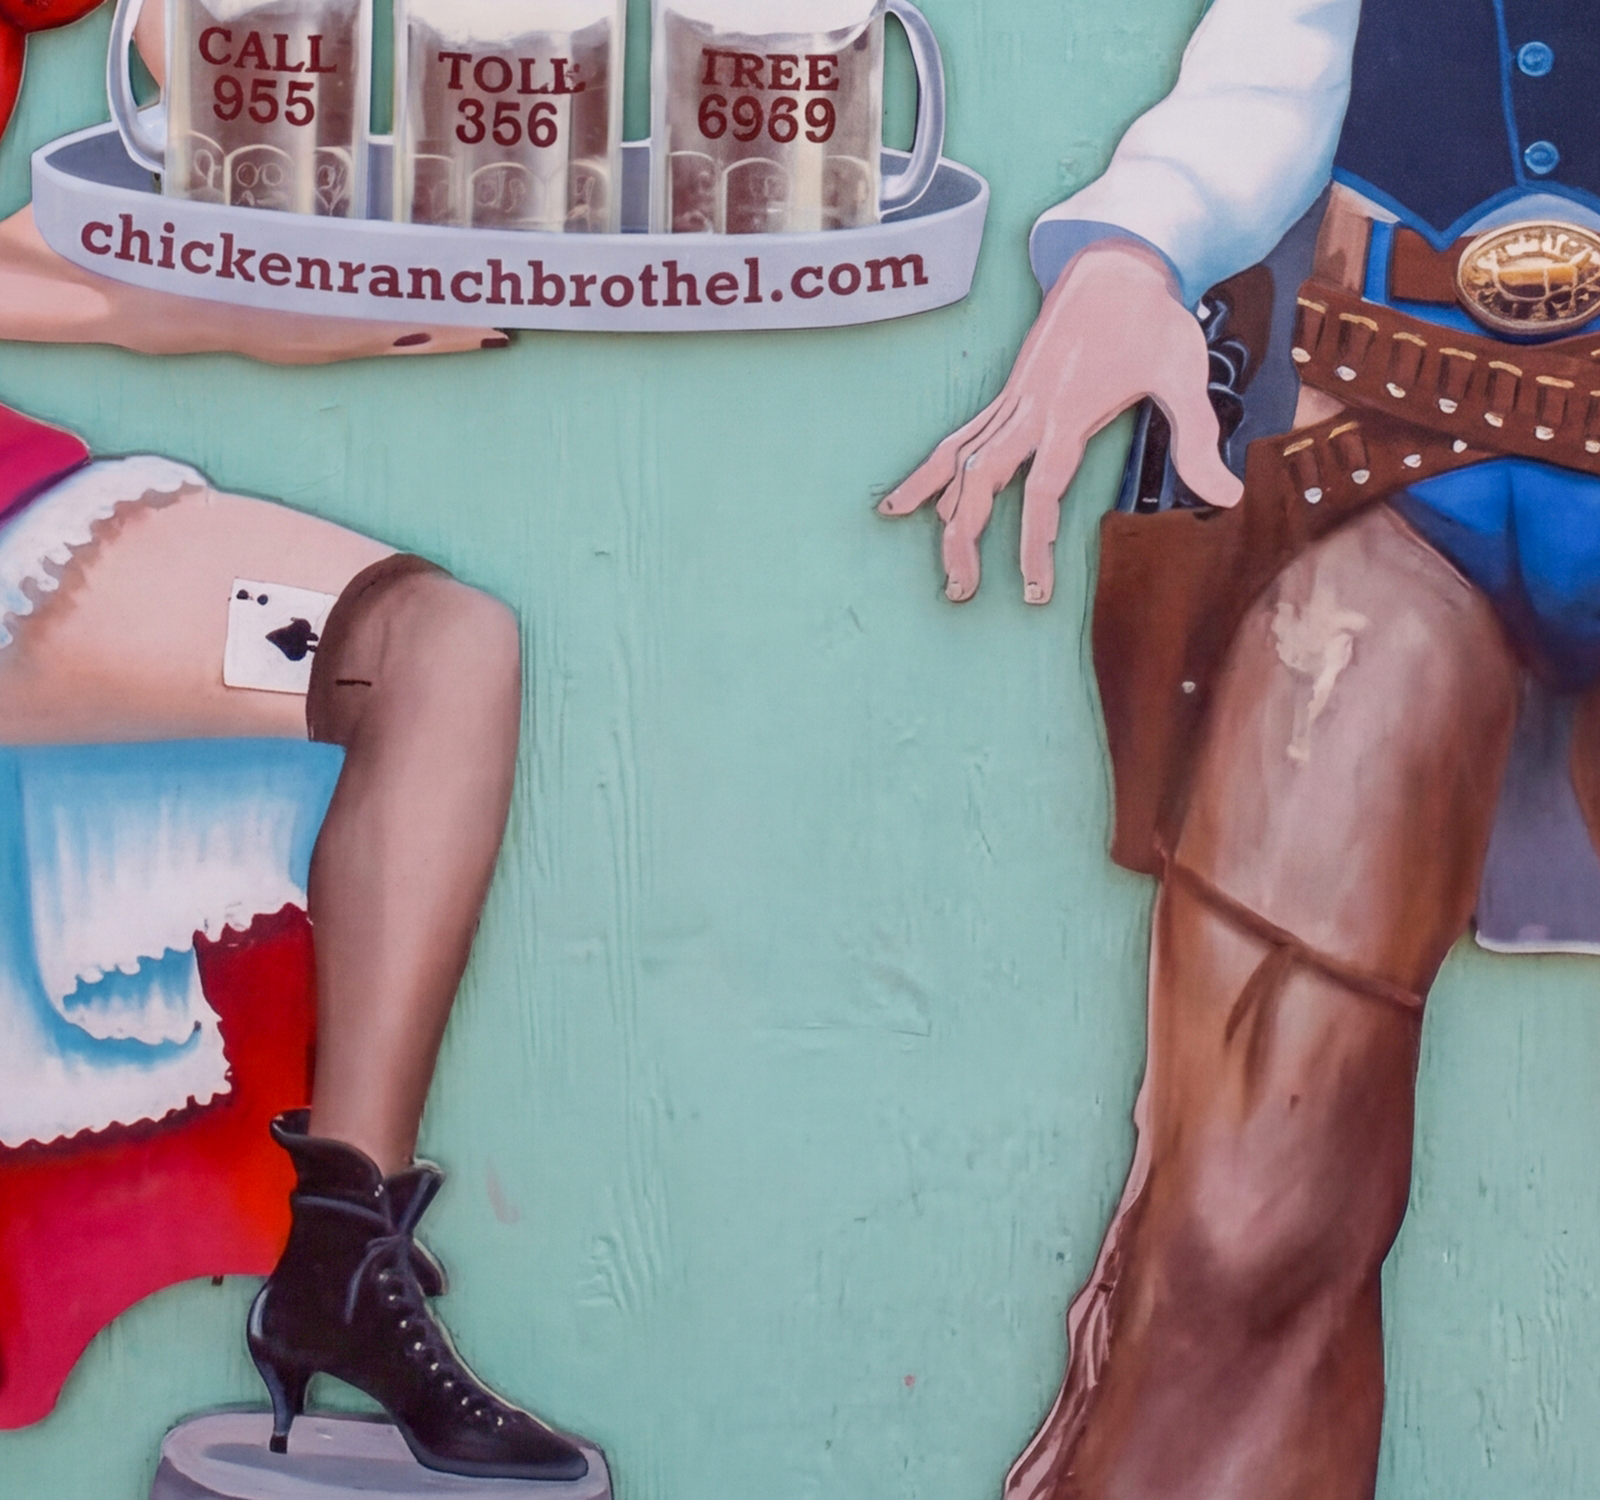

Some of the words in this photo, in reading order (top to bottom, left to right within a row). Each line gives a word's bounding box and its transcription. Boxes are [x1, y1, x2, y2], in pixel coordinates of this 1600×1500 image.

[198, 26, 338, 74] CALL
[437, 51, 587, 95] TOLL
[212, 74, 316, 127] 955
[455, 97, 558, 148] 356
[697, 93, 837, 144] 6969
[80, 212, 930, 309] chickenranchbrothel.com
